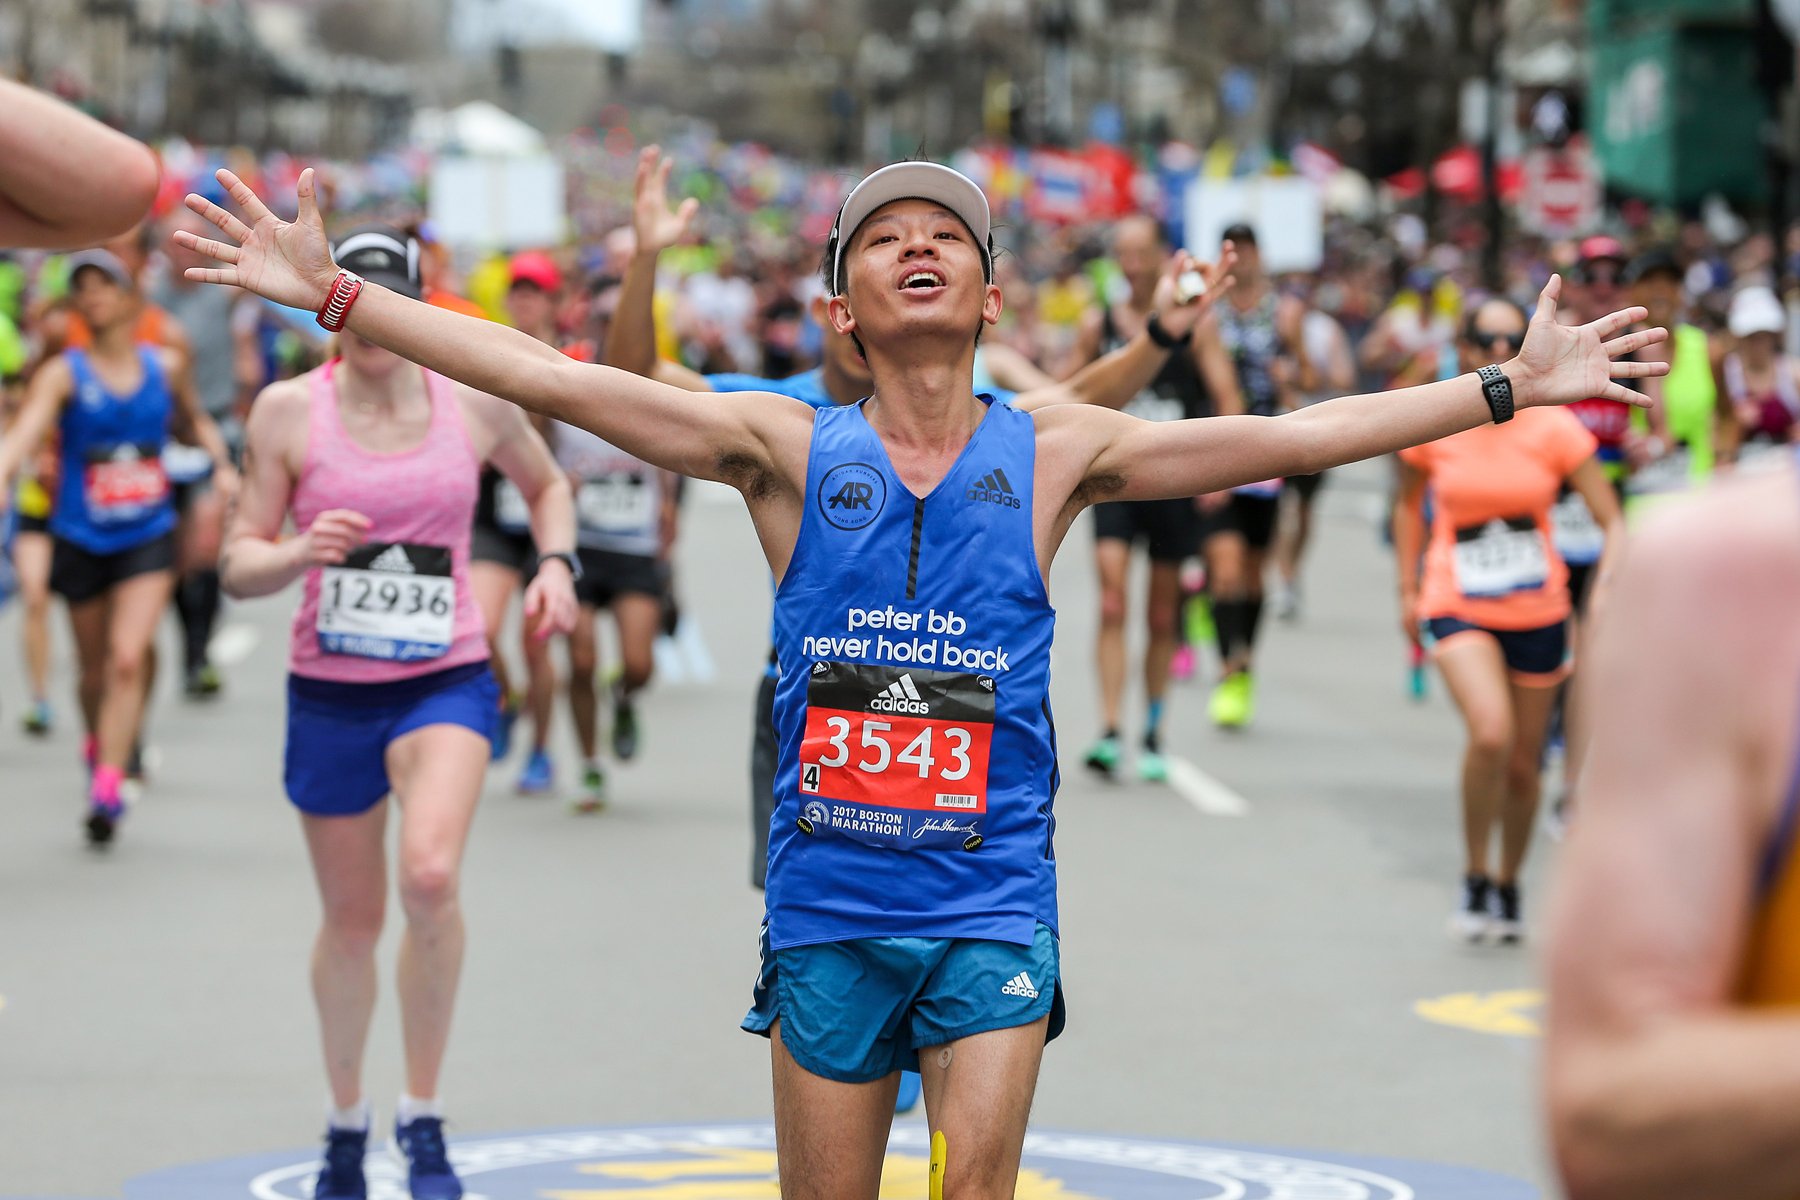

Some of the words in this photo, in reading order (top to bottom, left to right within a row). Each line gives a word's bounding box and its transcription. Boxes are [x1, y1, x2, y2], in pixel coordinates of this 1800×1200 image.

[828, 481, 873, 510] AR
[966, 488, 1021, 510] adidas
[331, 575, 449, 619] 12936
[848, 605, 921, 632] peter
[927, 609, 967, 636] bb
[802, 636, 872, 658] never
[876, 635, 938, 664] hold
[942, 641, 1010, 671] back
[870, 698, 930, 714] adidas
[818, 716, 972, 781] 3543
[803, 766, 818, 790] 4
[832, 805, 857, 818] 2017
[859, 810, 903, 824] BOSTON
[797, 818, 813, 834] boost
[832, 816, 902, 836] MARATHON
[912, 817, 941, 839] John
[965, 837, 982, 850] boost
[1001, 984, 1040, 999] adidas
